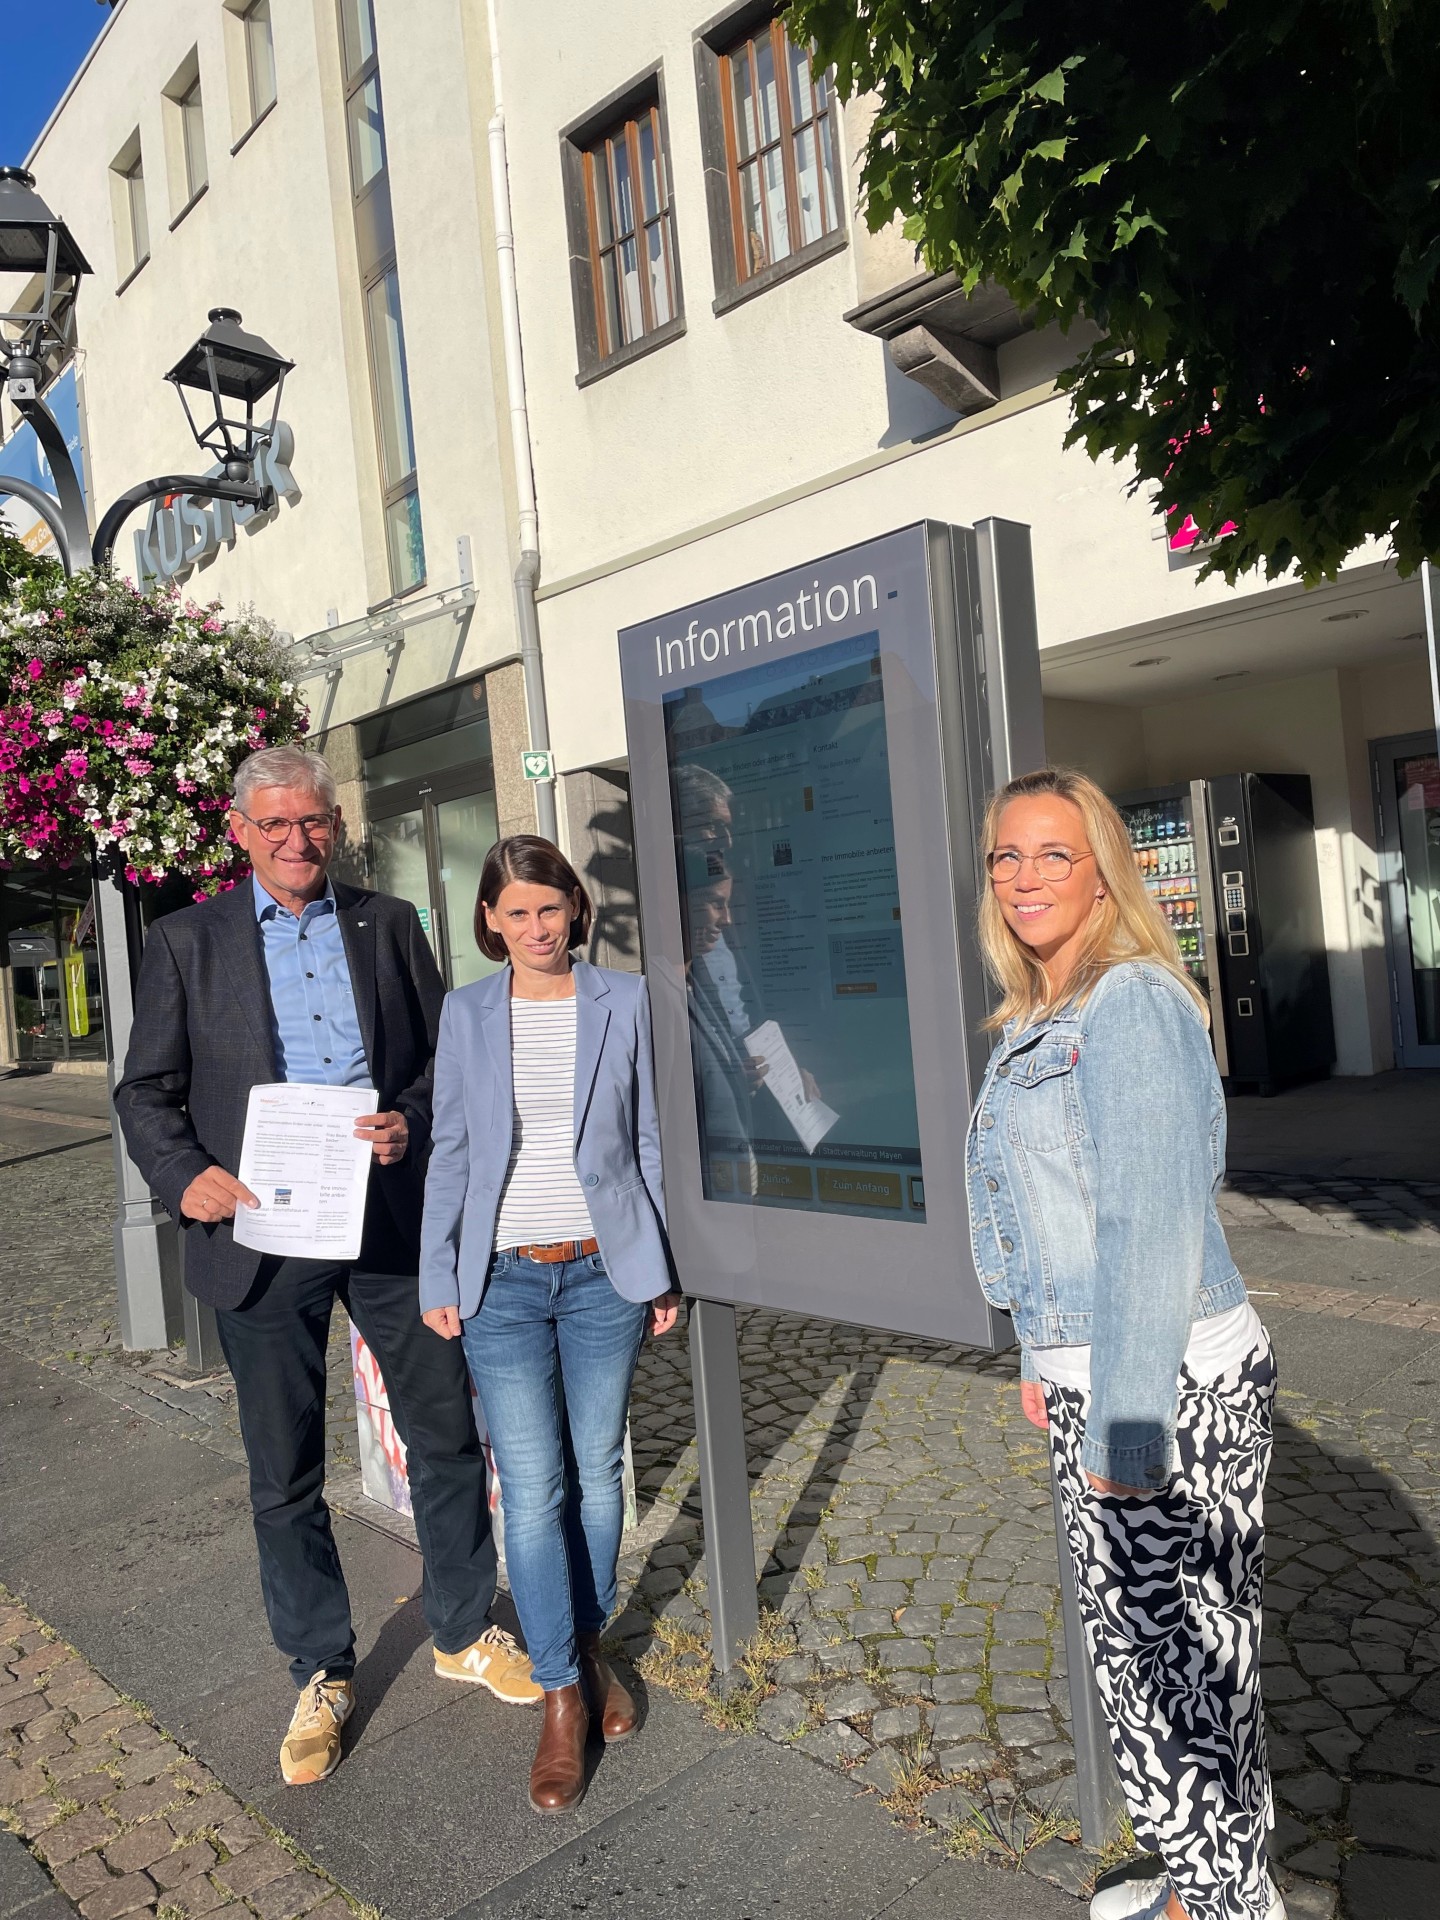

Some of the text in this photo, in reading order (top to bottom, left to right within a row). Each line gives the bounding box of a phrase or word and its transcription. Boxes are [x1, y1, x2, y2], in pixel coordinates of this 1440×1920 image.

[655, 573, 878, 677] Information
[823, 1147, 877, 1159] Stadtverwaltung
[879, 1150, 903, 1160] Mayen
[832, 1179, 890, 1195] Zum Anfang
